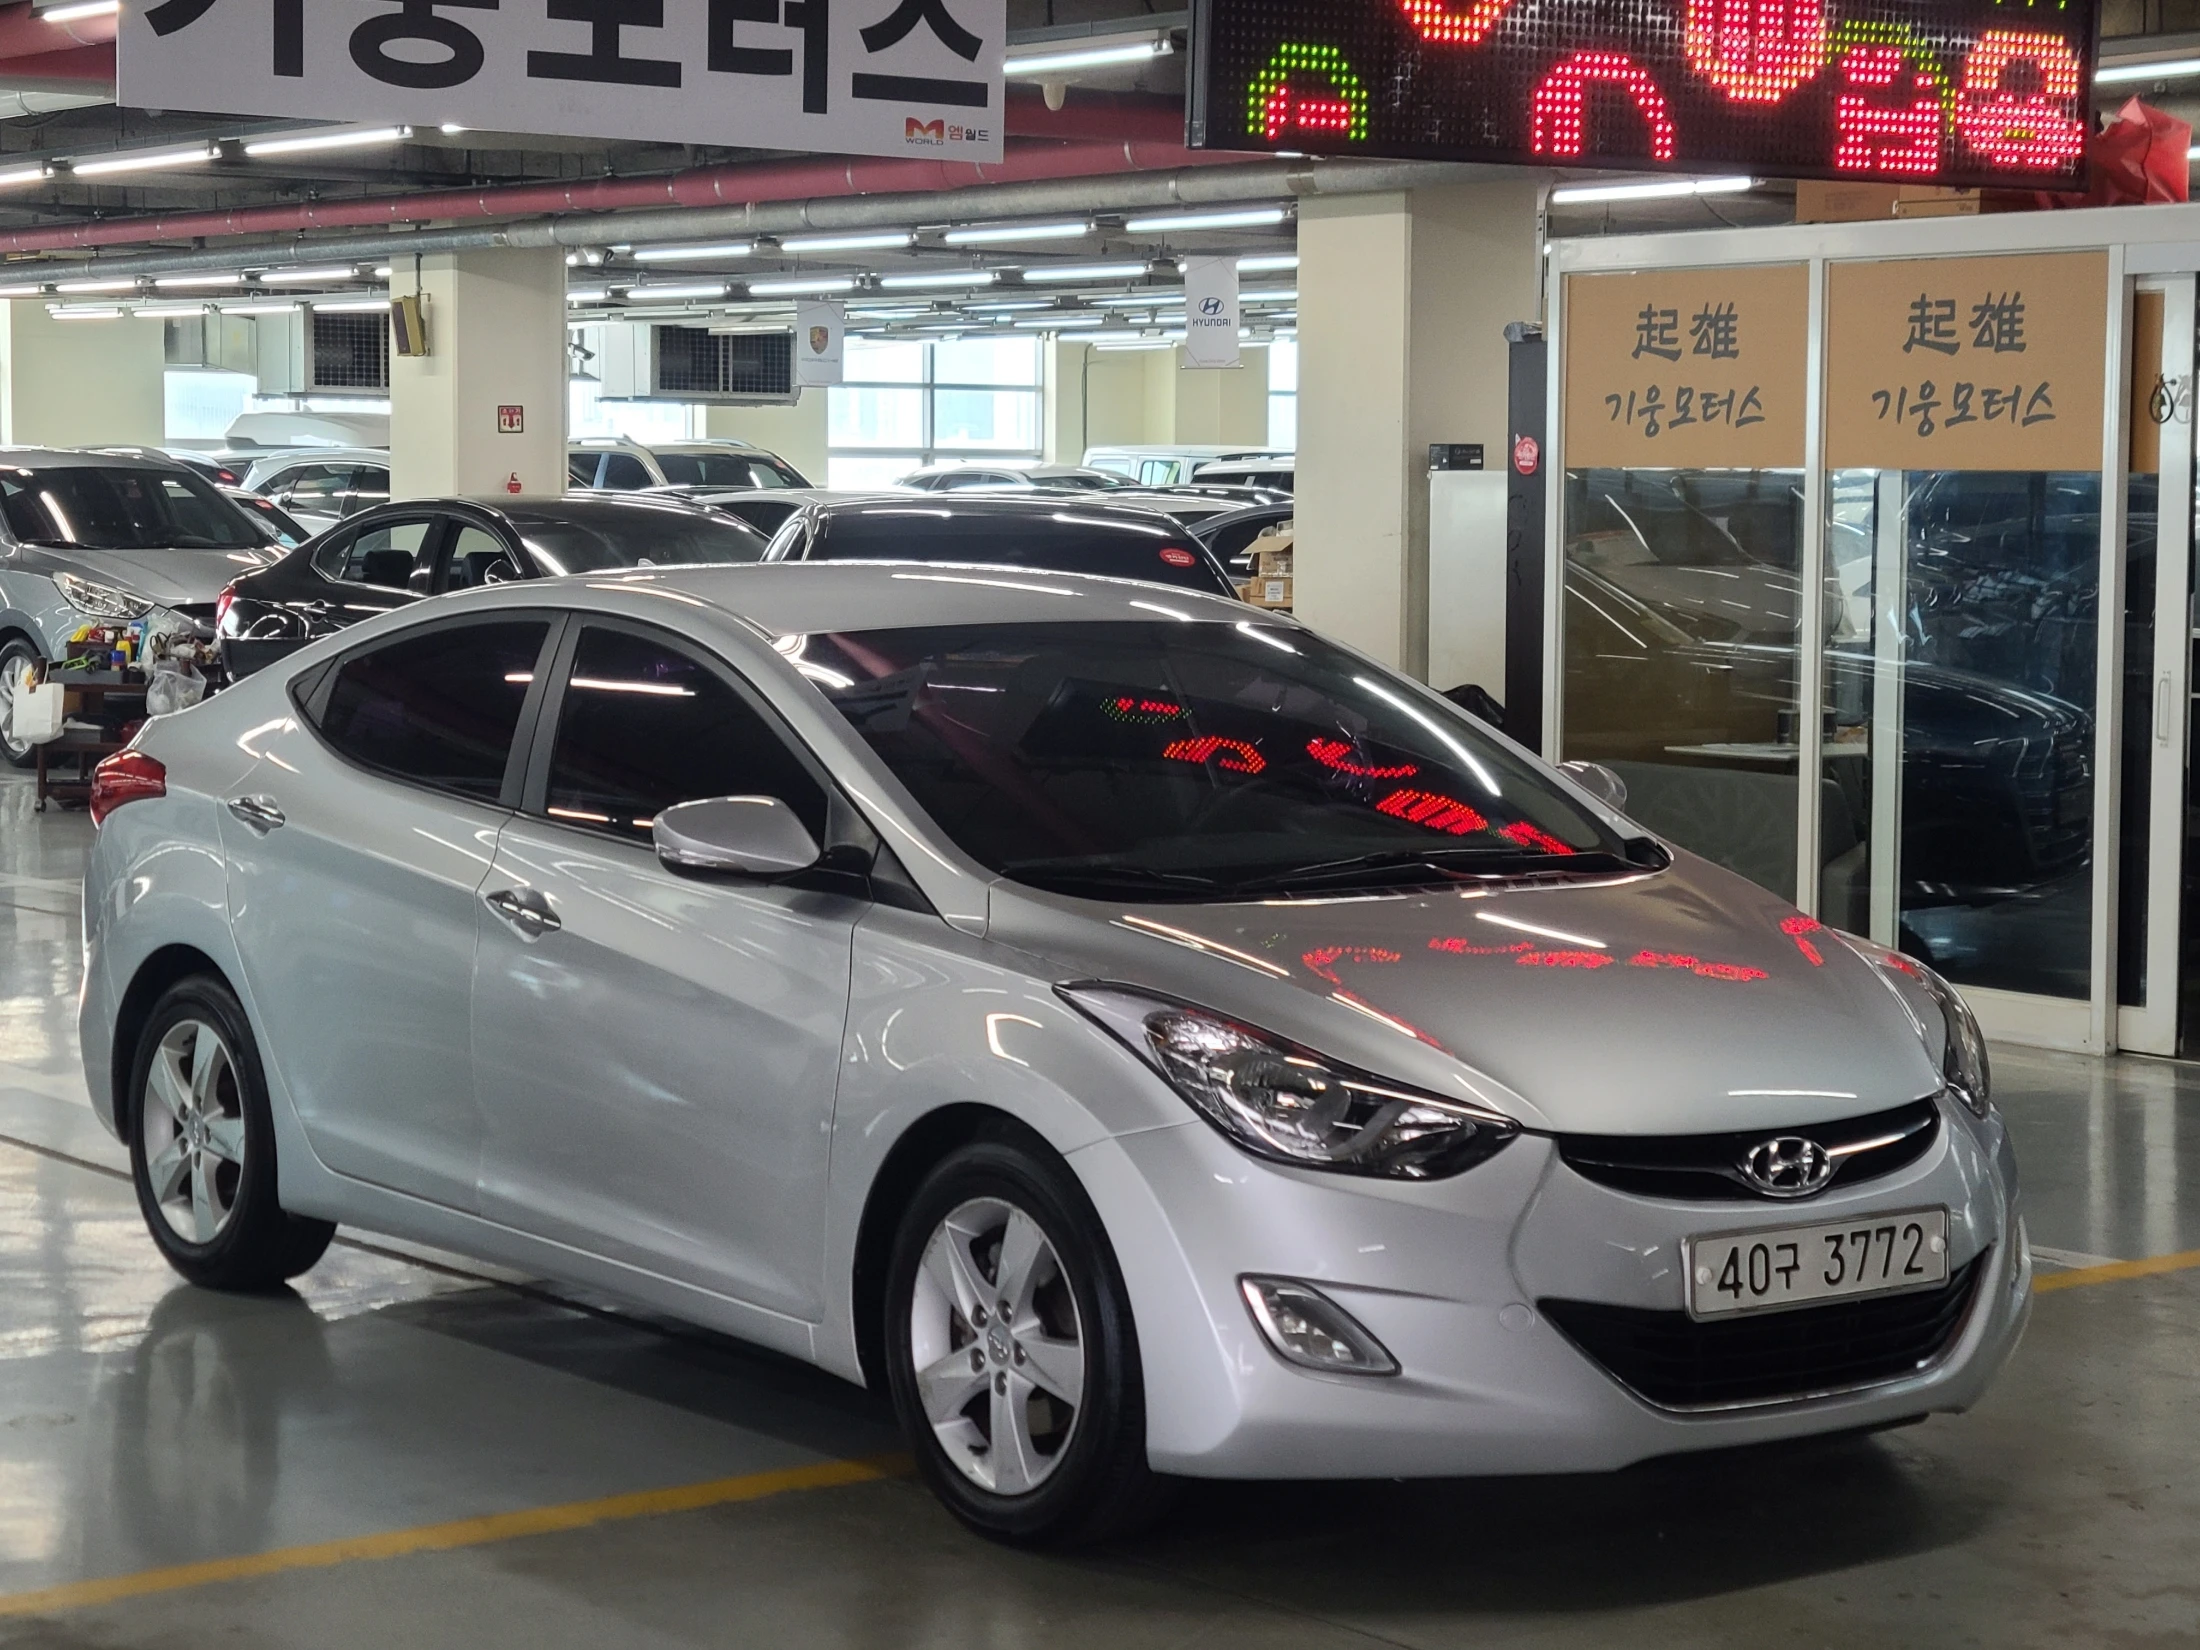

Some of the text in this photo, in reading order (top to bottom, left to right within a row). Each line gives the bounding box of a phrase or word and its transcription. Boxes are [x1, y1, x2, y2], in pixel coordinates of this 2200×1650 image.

[904, 138, 944, 146] WORLD
[947, 125, 989, 142] 엠월드
[1192, 318, 1231, 327] HYUNDAI
[1631, 302, 1740, 362] 起雄
[1902, 291, 2027, 356] 起雄
[1605, 384, 1766, 438] 기웅모터스
[1872, 380, 2056, 437] 기웅모터스
[1717, 1223, 1924, 1299] 40구 3772
